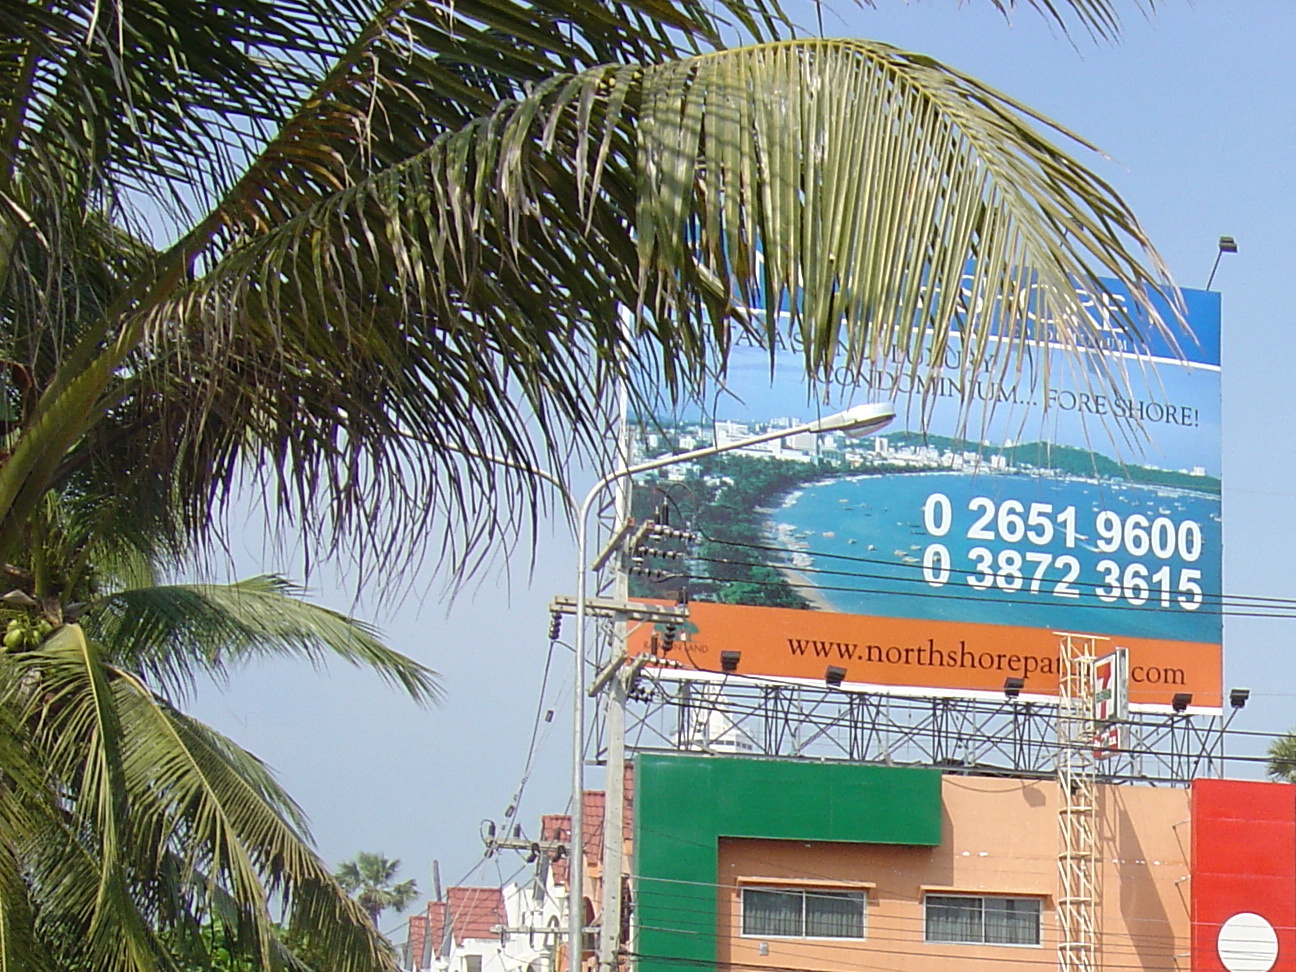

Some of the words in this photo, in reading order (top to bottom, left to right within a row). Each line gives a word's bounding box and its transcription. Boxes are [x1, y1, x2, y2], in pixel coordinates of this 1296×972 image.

[1046, 388, 1108, 415] FORE
[1114, 398, 1200, 428] SHORE!
[924, 492, 953, 537] 0
[966, 496, 1077, 548] 2651
[1095, 510, 1203, 562] 9600
[922, 543, 951, 587] 0
[966, 546, 1081, 598] 3872
[1094, 559, 1203, 611] 3615
